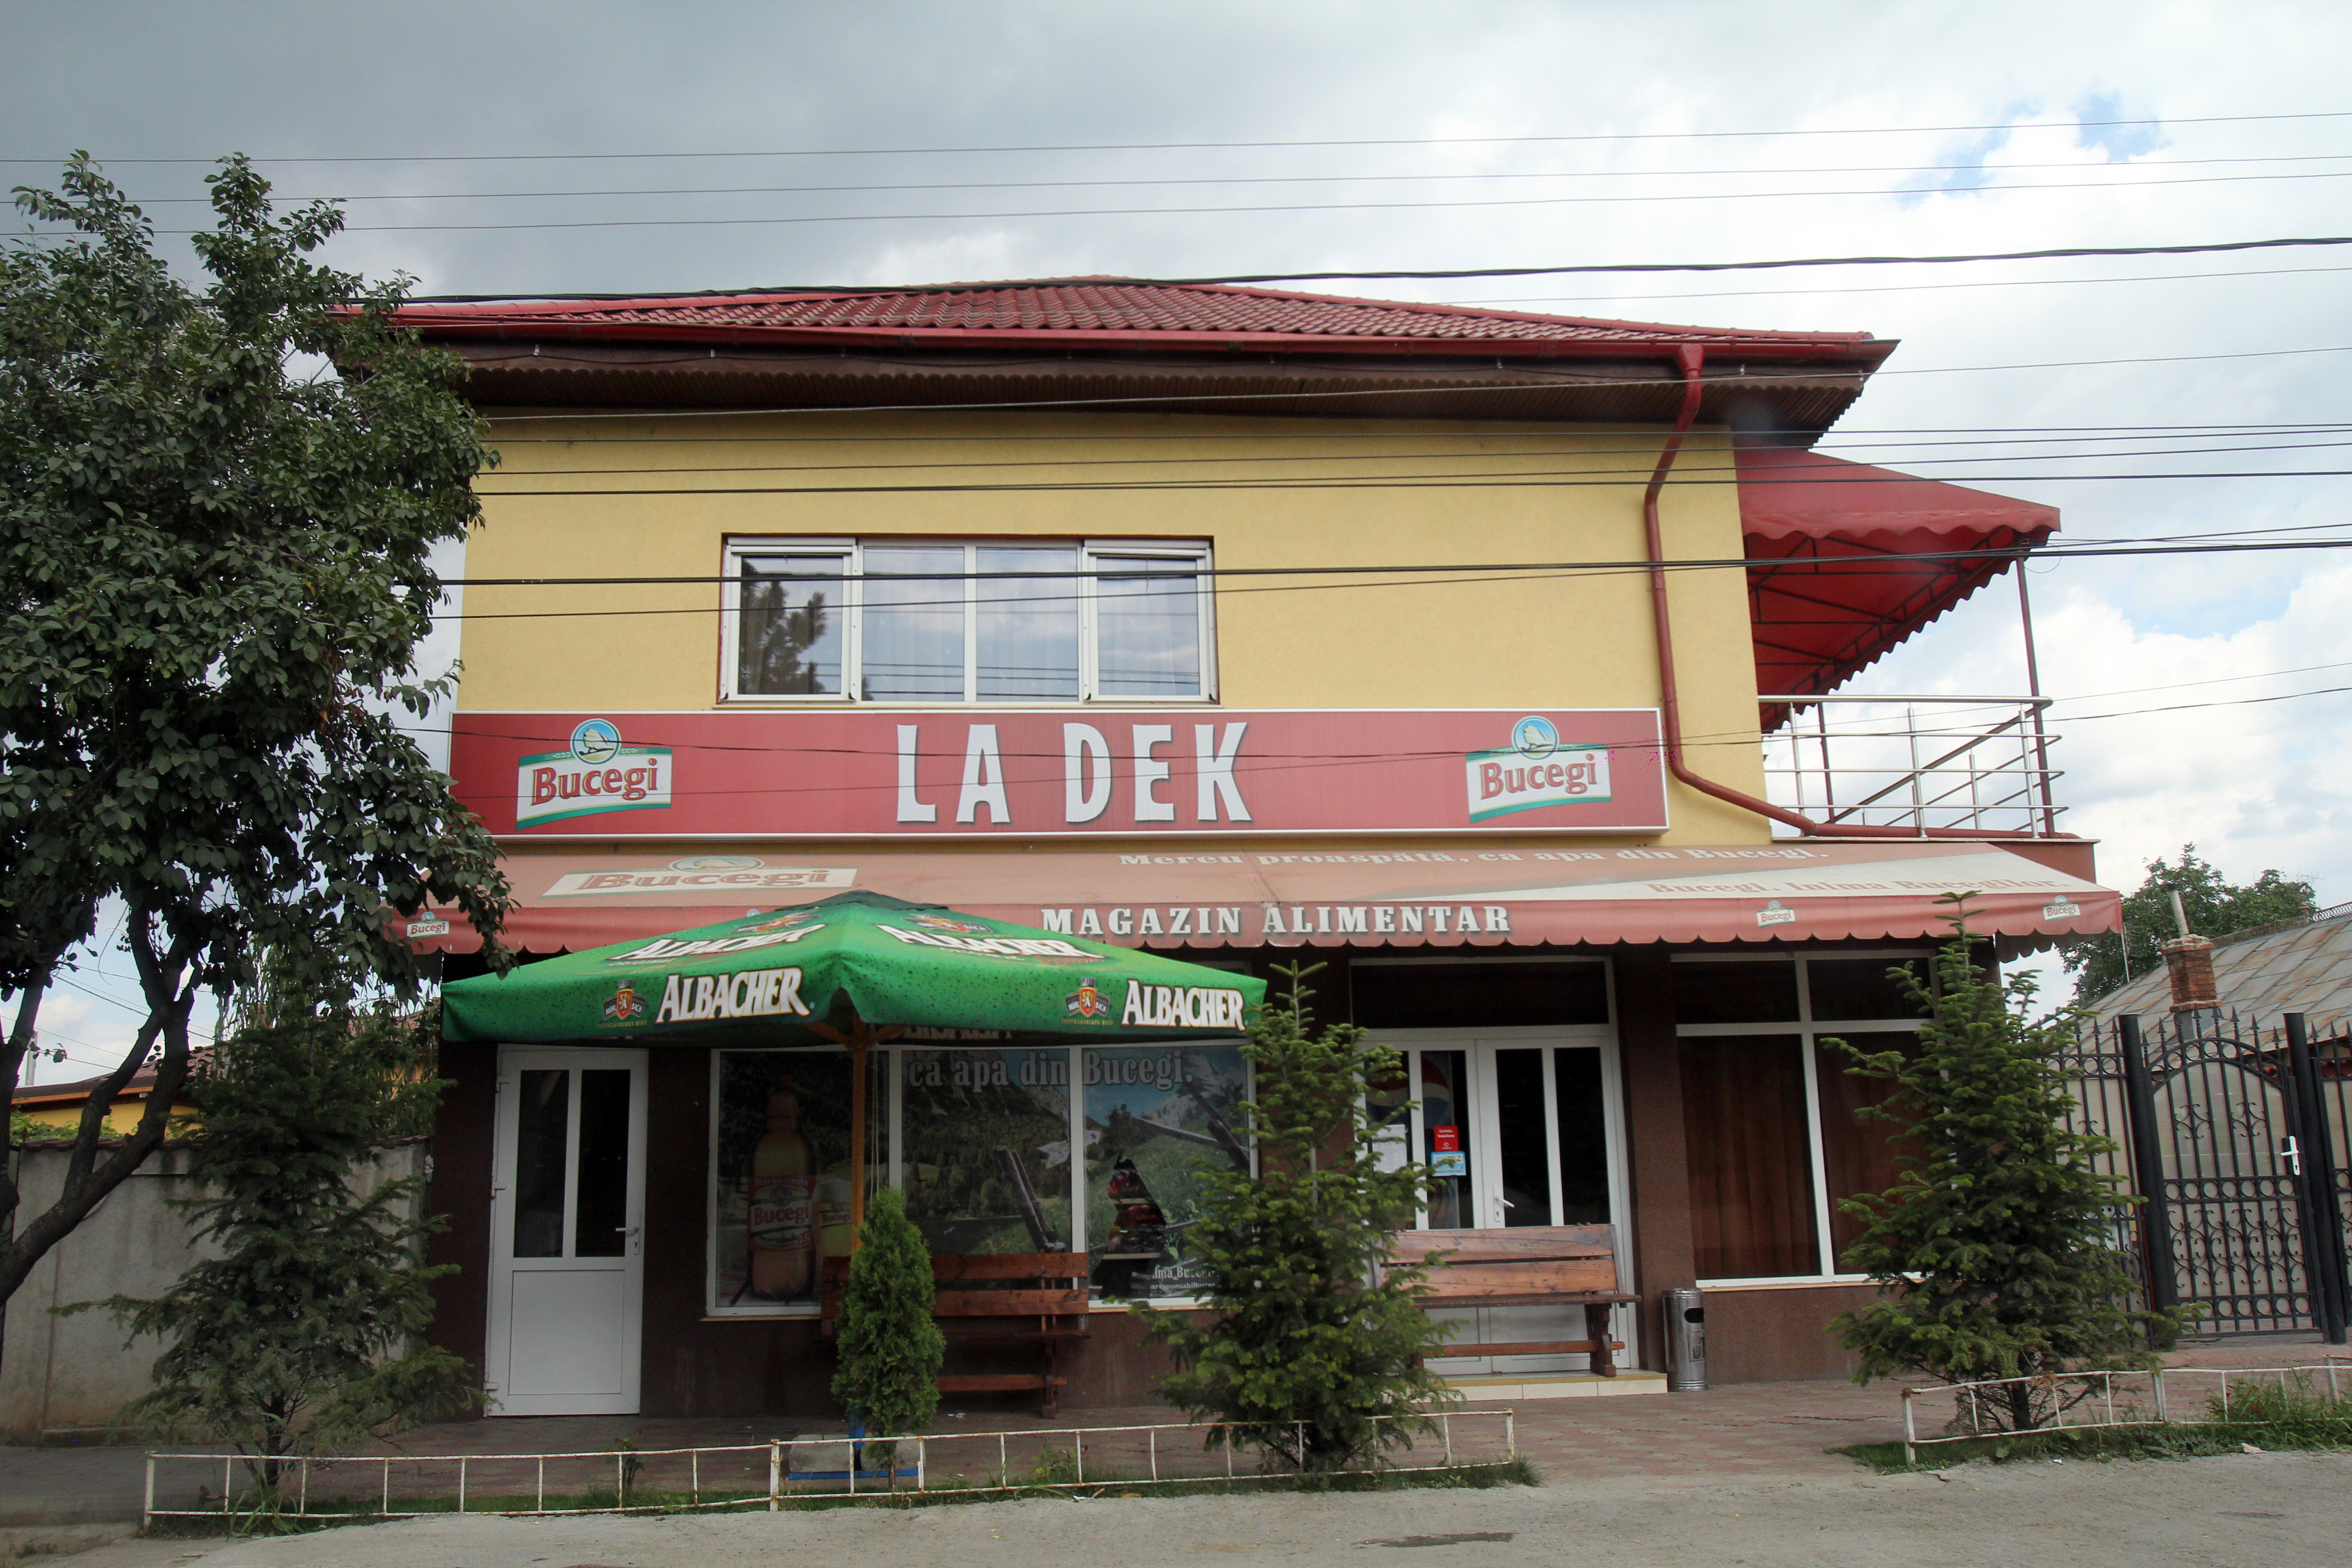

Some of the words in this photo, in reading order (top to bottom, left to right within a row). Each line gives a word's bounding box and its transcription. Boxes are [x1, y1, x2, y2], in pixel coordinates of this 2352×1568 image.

[531, 758, 658, 806] Bucegi
[897, 724, 1010, 823] LA
[1063, 722, 1252, 823] DEK
[1480, 753, 1598, 800] Bucegi
[1118, 854, 1245, 865] Mereu
[1478, 852, 1524, 861] ca
[1534, 851, 1607, 862] apa
[1616, 849, 1680, 859] din
[1681, 848, 1830, 860] Bucegi.
[575, 870, 830, 890] Bucegi
[1645, 882, 1781, 893] Bucegi.
[1783, 881, 1892, 891] Inima
[1891, 879, 2070, 891] Bucegilor.
[1041, 906, 1241, 936] MAGAZIN
[1263, 906, 1512, 934] ALIMENTAR
[1760, 911, 1792, 922] Bucegi
[2047, 905, 2077, 916] Bucegi
[411, 922, 446, 935] Bucegi
[655, 967, 810, 1024] ALBACHER
[1121, 979, 1246, 1031] ALBACHER
[909, 1060, 942, 1086] ca
[953, 1059, 1010, 1093] apa
[1020, 1052, 1068, 1085] din
[1083, 1050, 1194, 1091] Bucegi.
[754, 1201, 809, 1226] Bucegi
